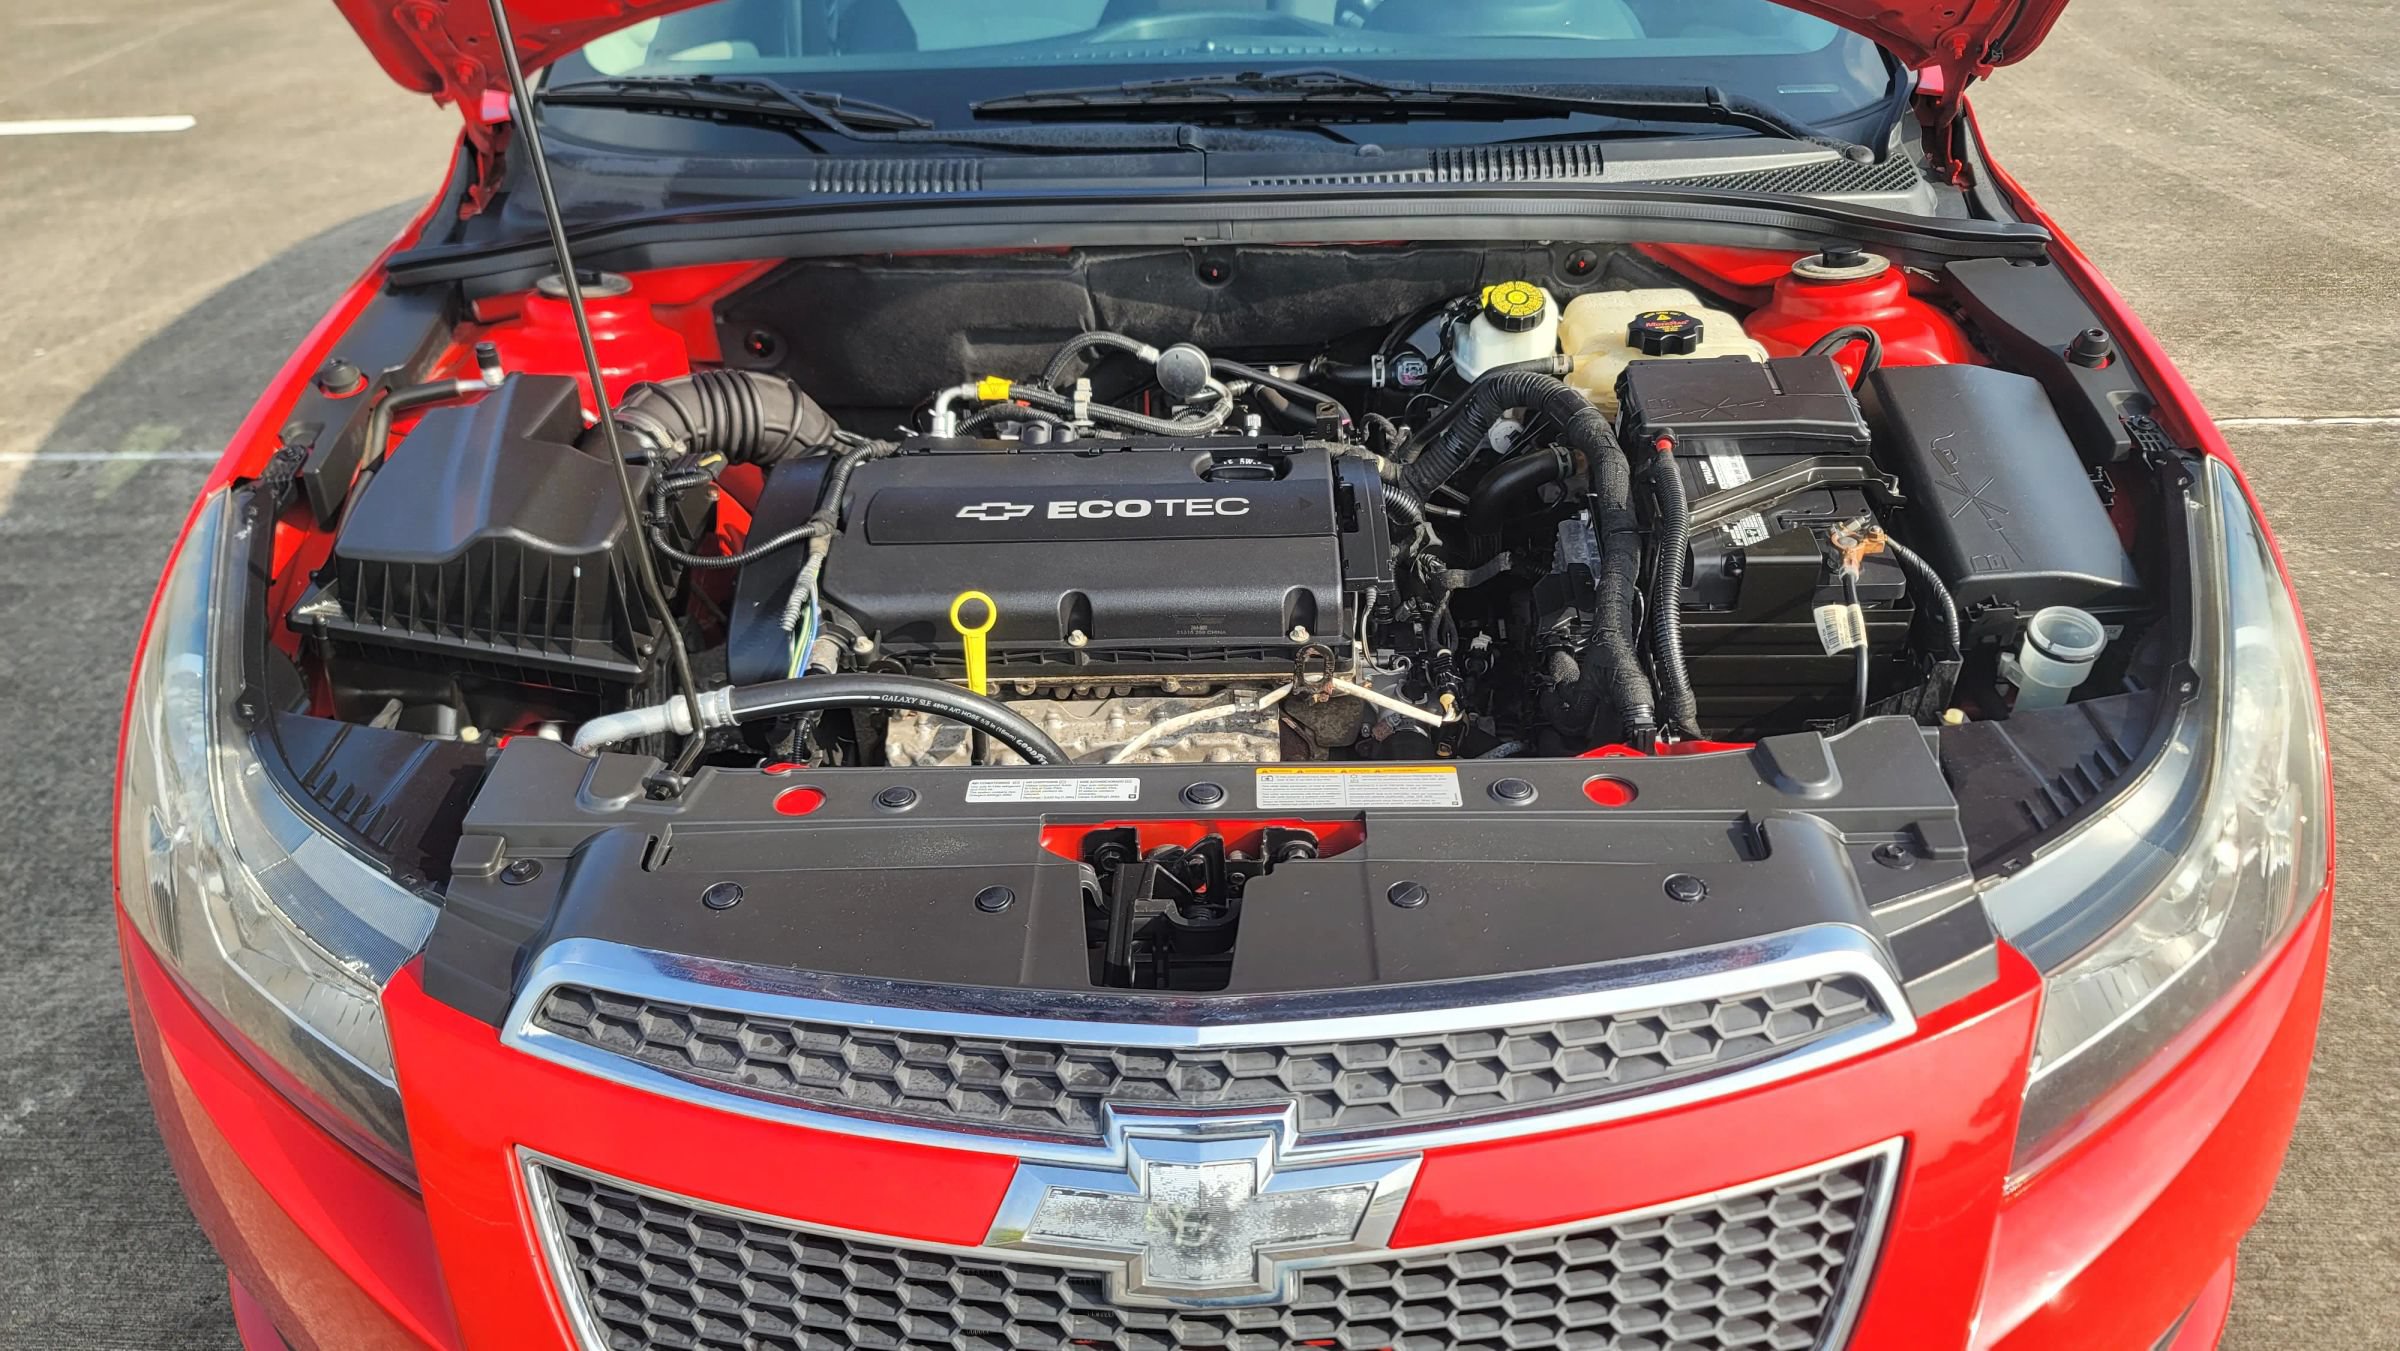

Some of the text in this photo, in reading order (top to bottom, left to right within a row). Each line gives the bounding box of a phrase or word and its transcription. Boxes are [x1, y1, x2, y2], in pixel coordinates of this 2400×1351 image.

[1046, 497, 1249, 519] ECOTEC
[881, 694, 918, 704] GALAXY
[948, 706, 961, 715] A/C
[961, 709, 982, 722] HOSE
